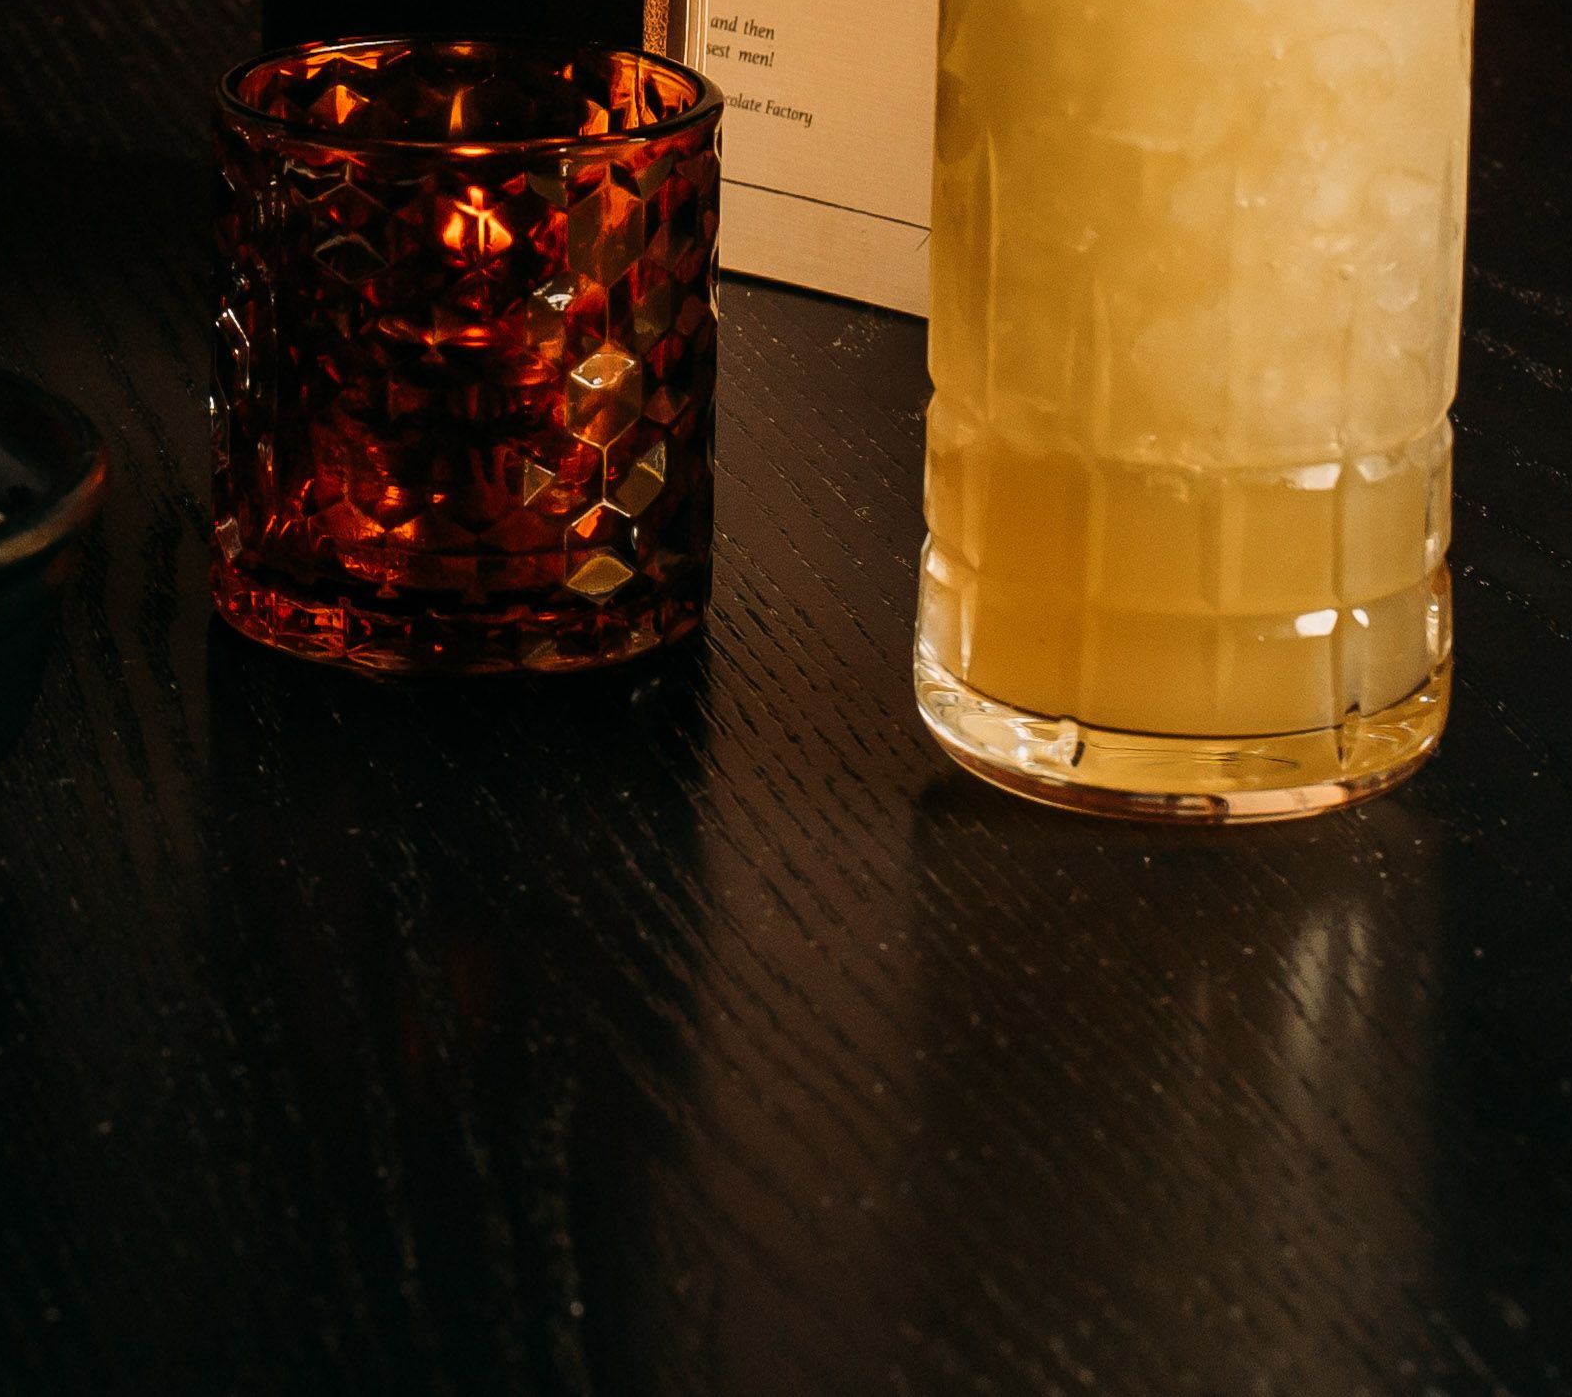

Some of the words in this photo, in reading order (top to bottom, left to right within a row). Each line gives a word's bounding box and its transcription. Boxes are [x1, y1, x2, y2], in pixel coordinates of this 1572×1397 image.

[710, 15, 738, 33] and
[743, 18, 775, 40] then
[738, 50, 775, 67] men!
[765, 99, 813, 129] Factory
